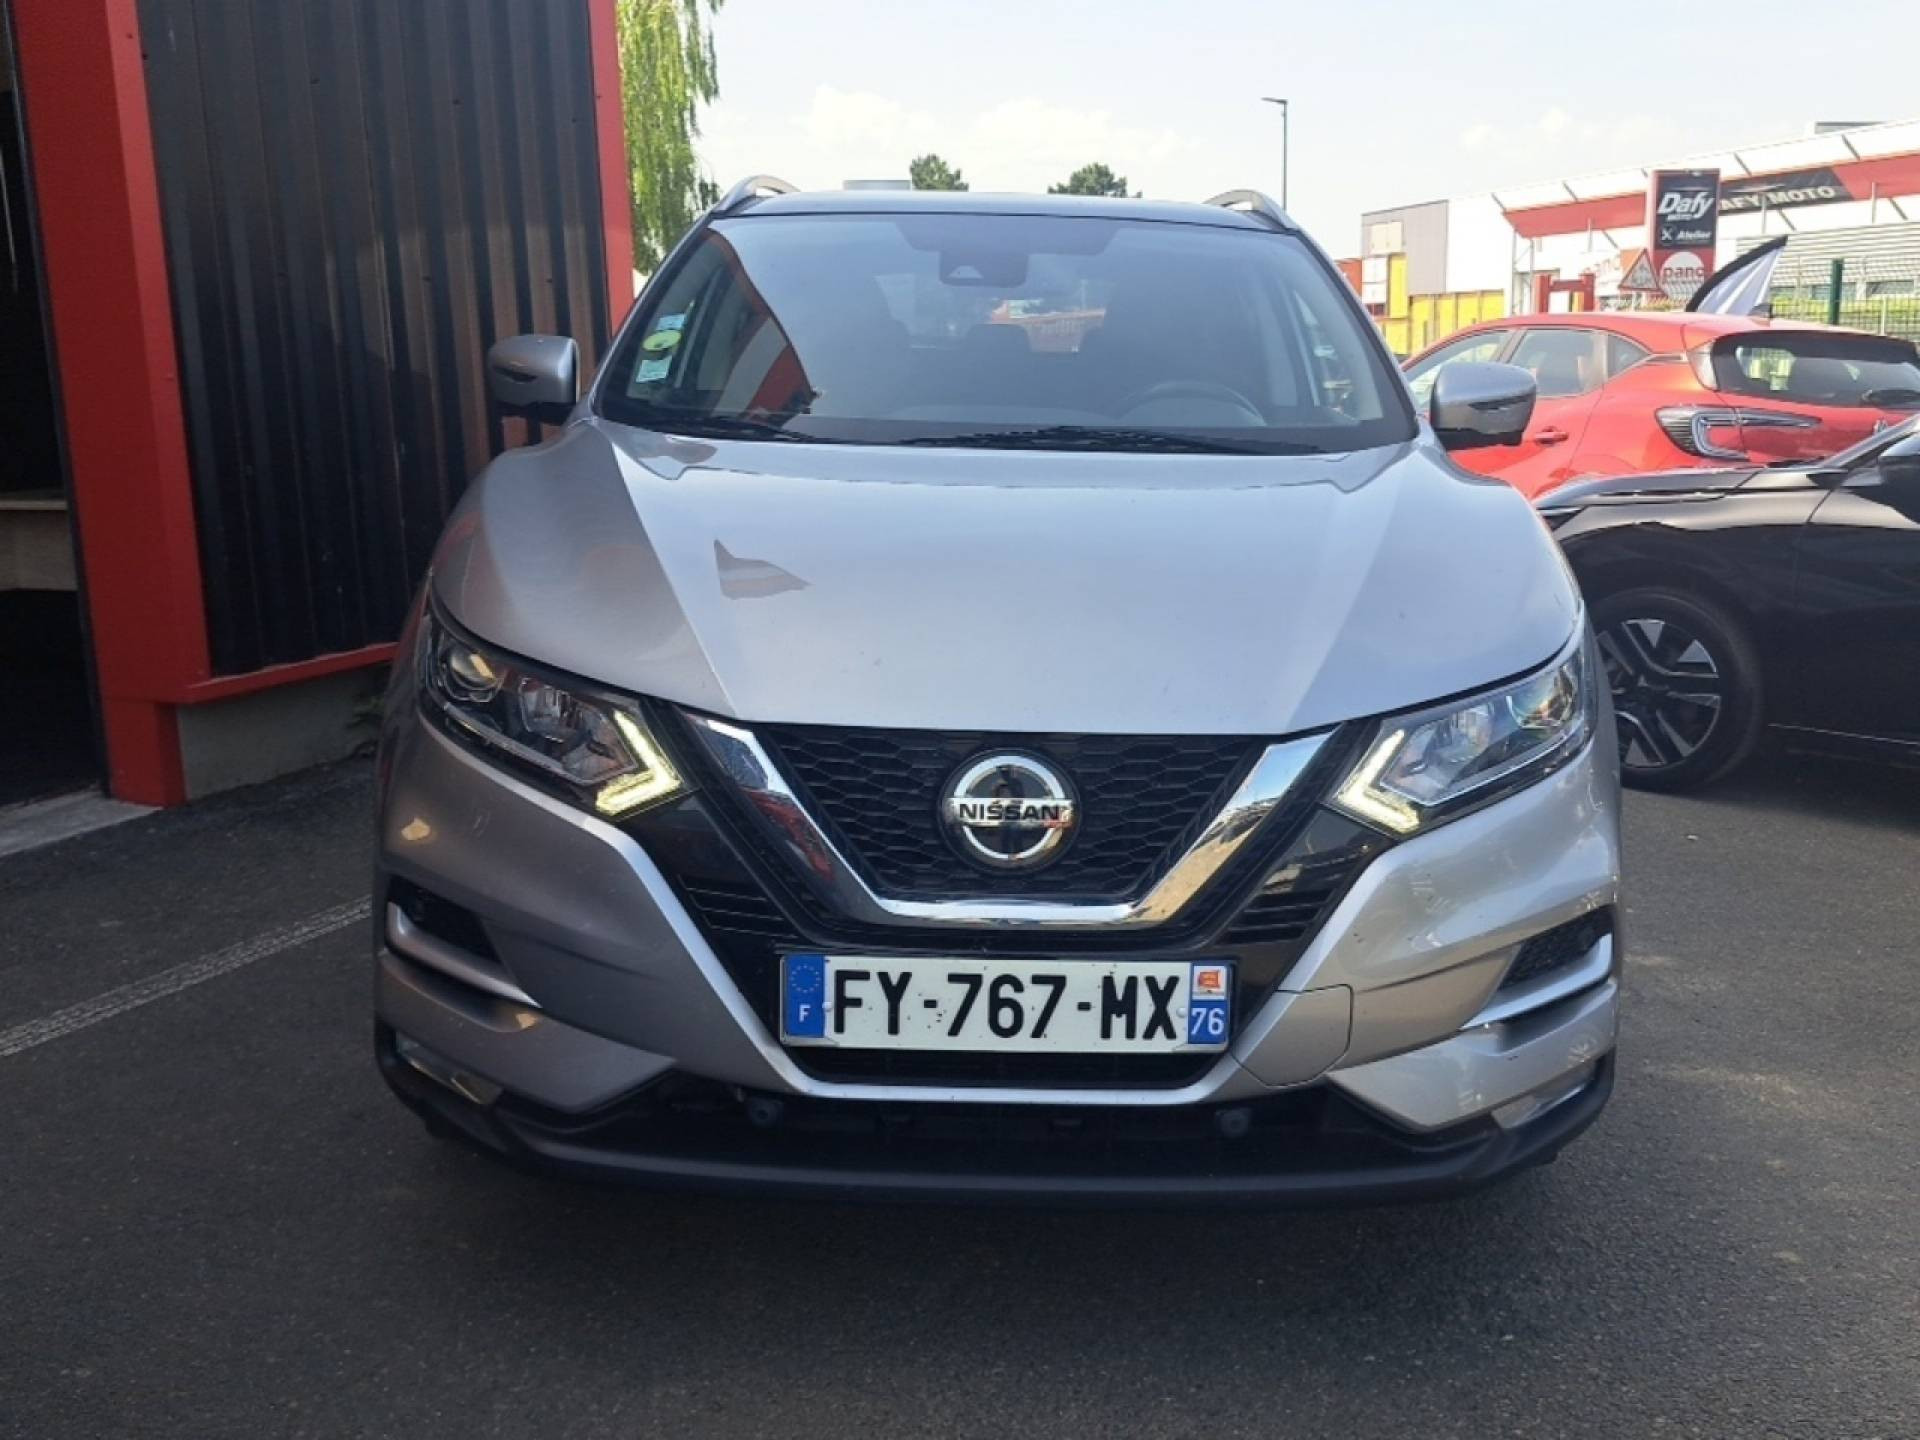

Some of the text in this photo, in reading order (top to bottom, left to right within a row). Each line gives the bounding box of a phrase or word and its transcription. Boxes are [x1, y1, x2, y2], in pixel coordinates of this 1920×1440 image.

[1657, 191, 1715, 219] Dafy
[1720, 185, 1835, 210] AFY MOTO
[959, 803, 1059, 820] NISSAN
[799, 1004, 811, 1023] F
[833, 969, 1181, 1042] FY-767-MX
[1191, 1007, 1225, 1035] 76
